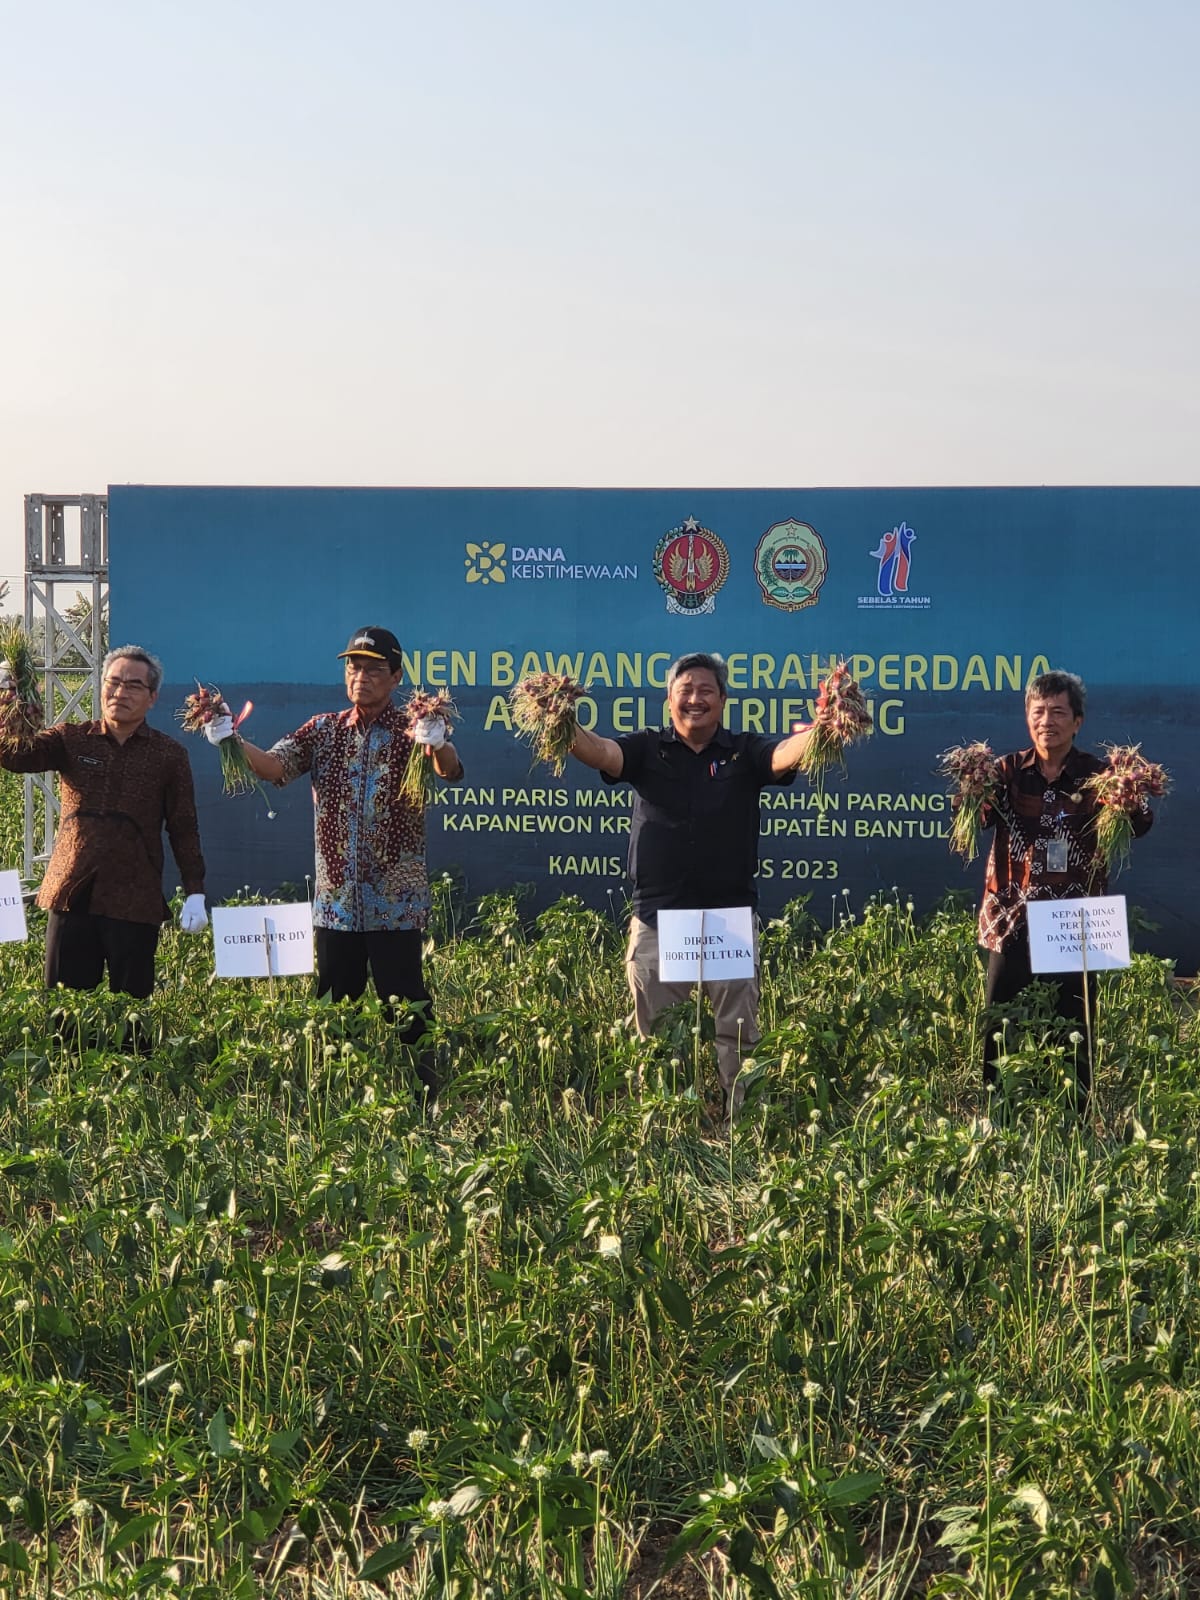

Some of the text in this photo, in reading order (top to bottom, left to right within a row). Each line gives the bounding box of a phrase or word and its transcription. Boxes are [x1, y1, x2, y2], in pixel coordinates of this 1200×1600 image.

[511, 547, 566, 562] DANA
[511, 564, 638, 580] KEISTIMEWAAN
[857, 596, 931, 604] SEBELAS TAHUN
[491, 651, 671, 688] BAWANG
[727, 652, 838, 690] ERAH
[852, 653, 1051, 692] PERDANA
[483, 695, 599, 732] AO
[425, 786, 495, 807] KTAN
[501, 788, 569, 807] PARIS
[575, 788, 633, 808] MAK
[758, 791, 840, 811] RAHAN
[443, 813, 593, 834] KAPANEWON
[758, 818, 847, 837] UPATEN
[854, 820, 950, 839] BANTUL
[780, 859, 839, 880] 2023
[1092, 907, 1116, 917] DINAS
[289, 930, 307, 942] DIY
[1046, 933, 1068, 943] DAN
[1100, 941, 1114, 951] DIY
